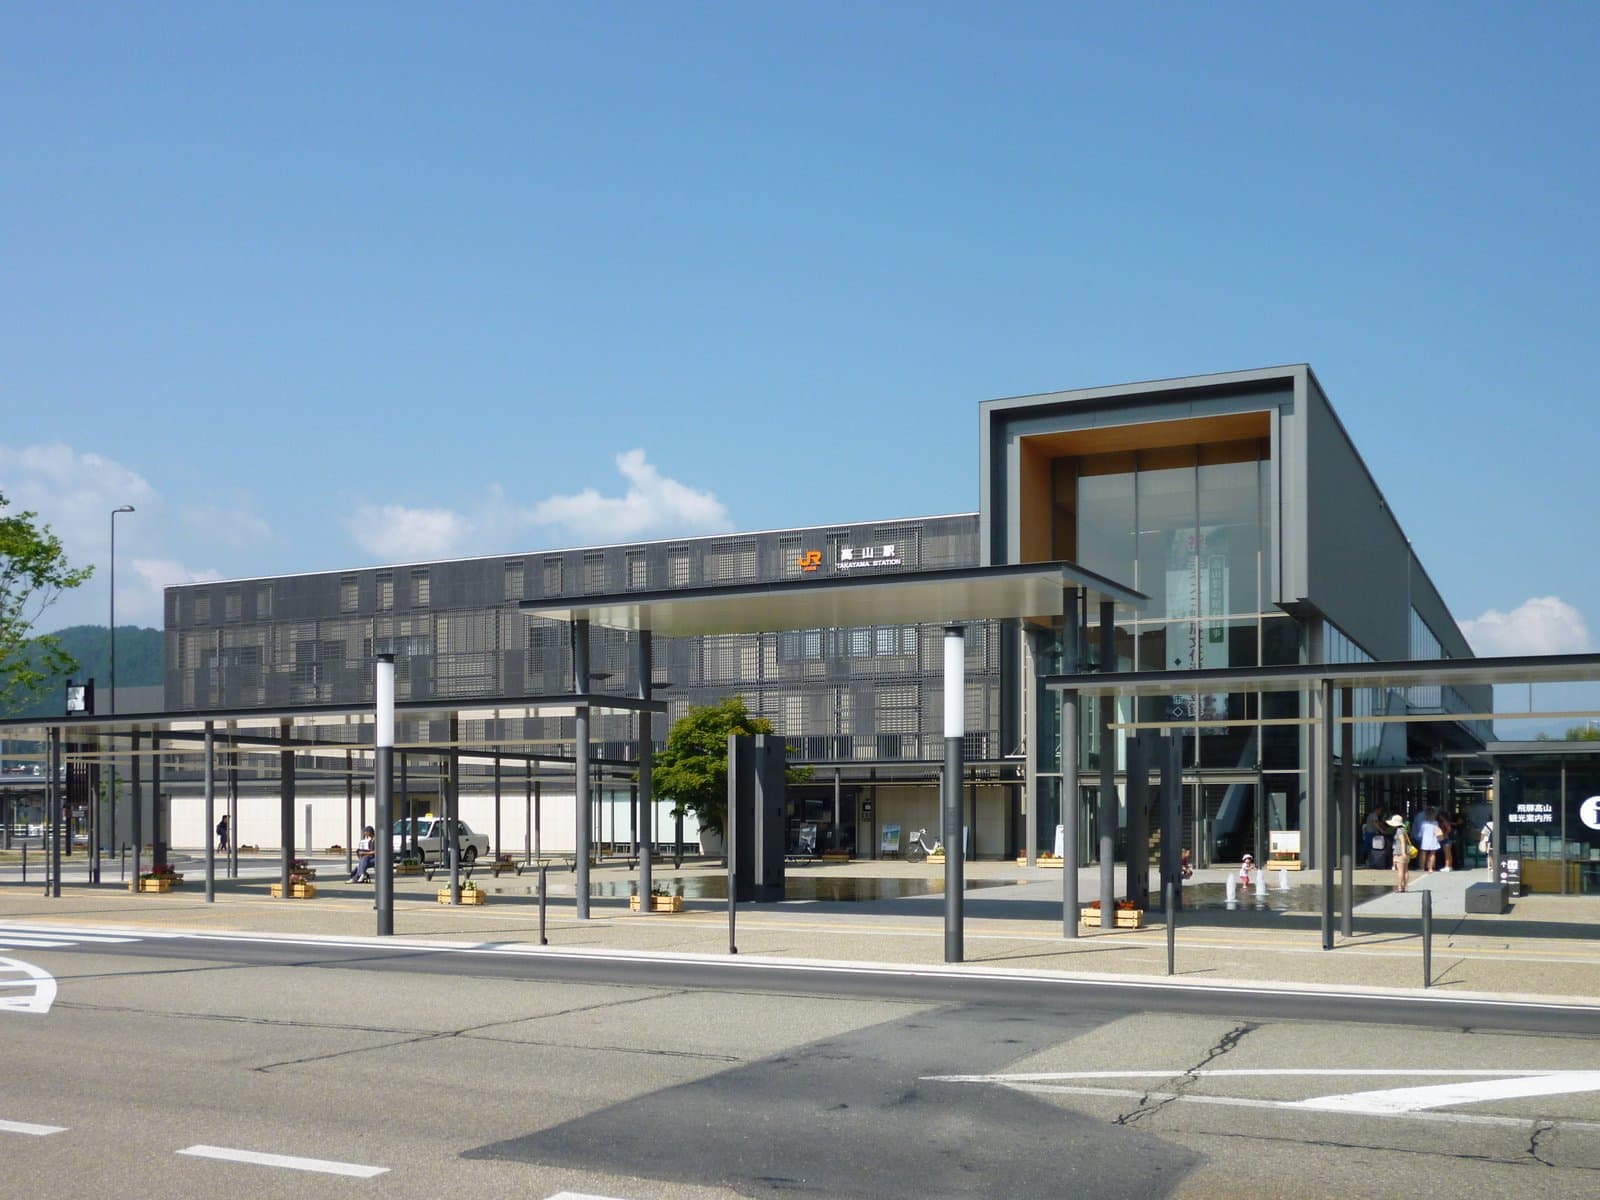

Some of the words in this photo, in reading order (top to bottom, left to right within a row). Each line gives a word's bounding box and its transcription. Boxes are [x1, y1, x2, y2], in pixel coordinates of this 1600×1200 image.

[798, 551, 822, 566] JR
[841, 545, 895, 560] 高山駅
[872, 559, 901, 567] STATION
